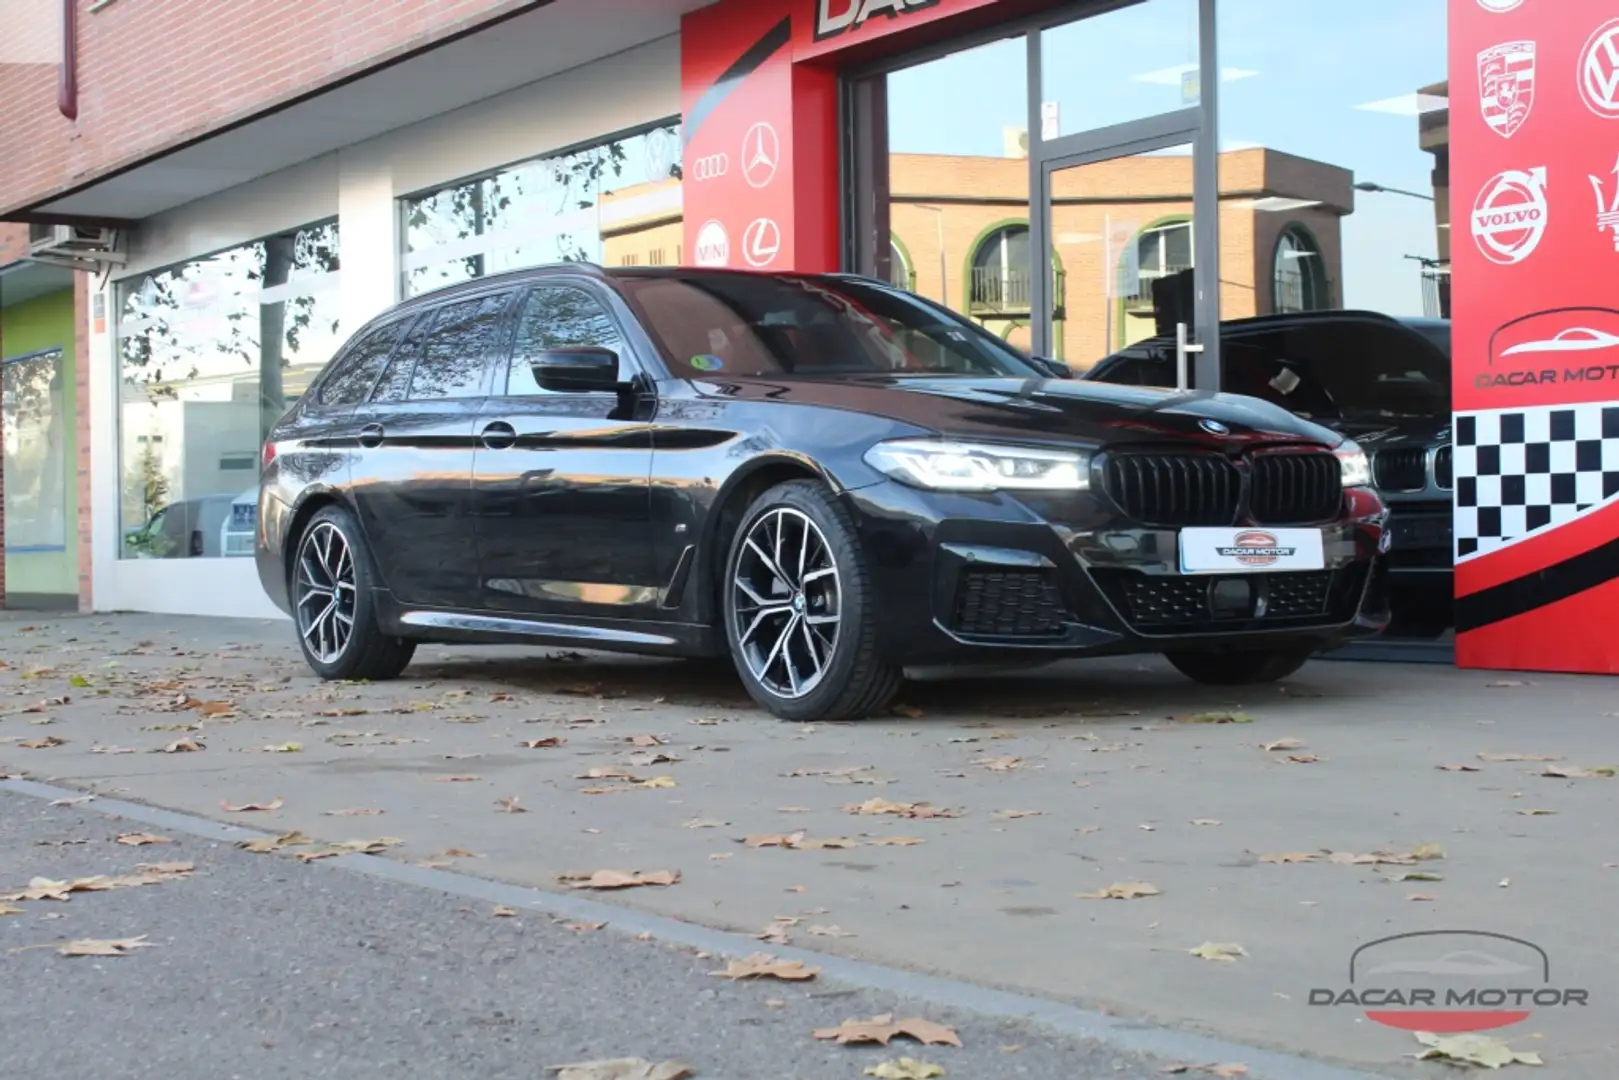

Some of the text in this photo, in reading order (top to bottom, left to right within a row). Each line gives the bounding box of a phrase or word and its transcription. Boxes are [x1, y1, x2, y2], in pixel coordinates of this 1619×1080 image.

[1477, 208, 1541, 228] VOLVO
[1473, 369, 1557, 389] DACAR
[1255, 548, 1290, 556] MOTOR
